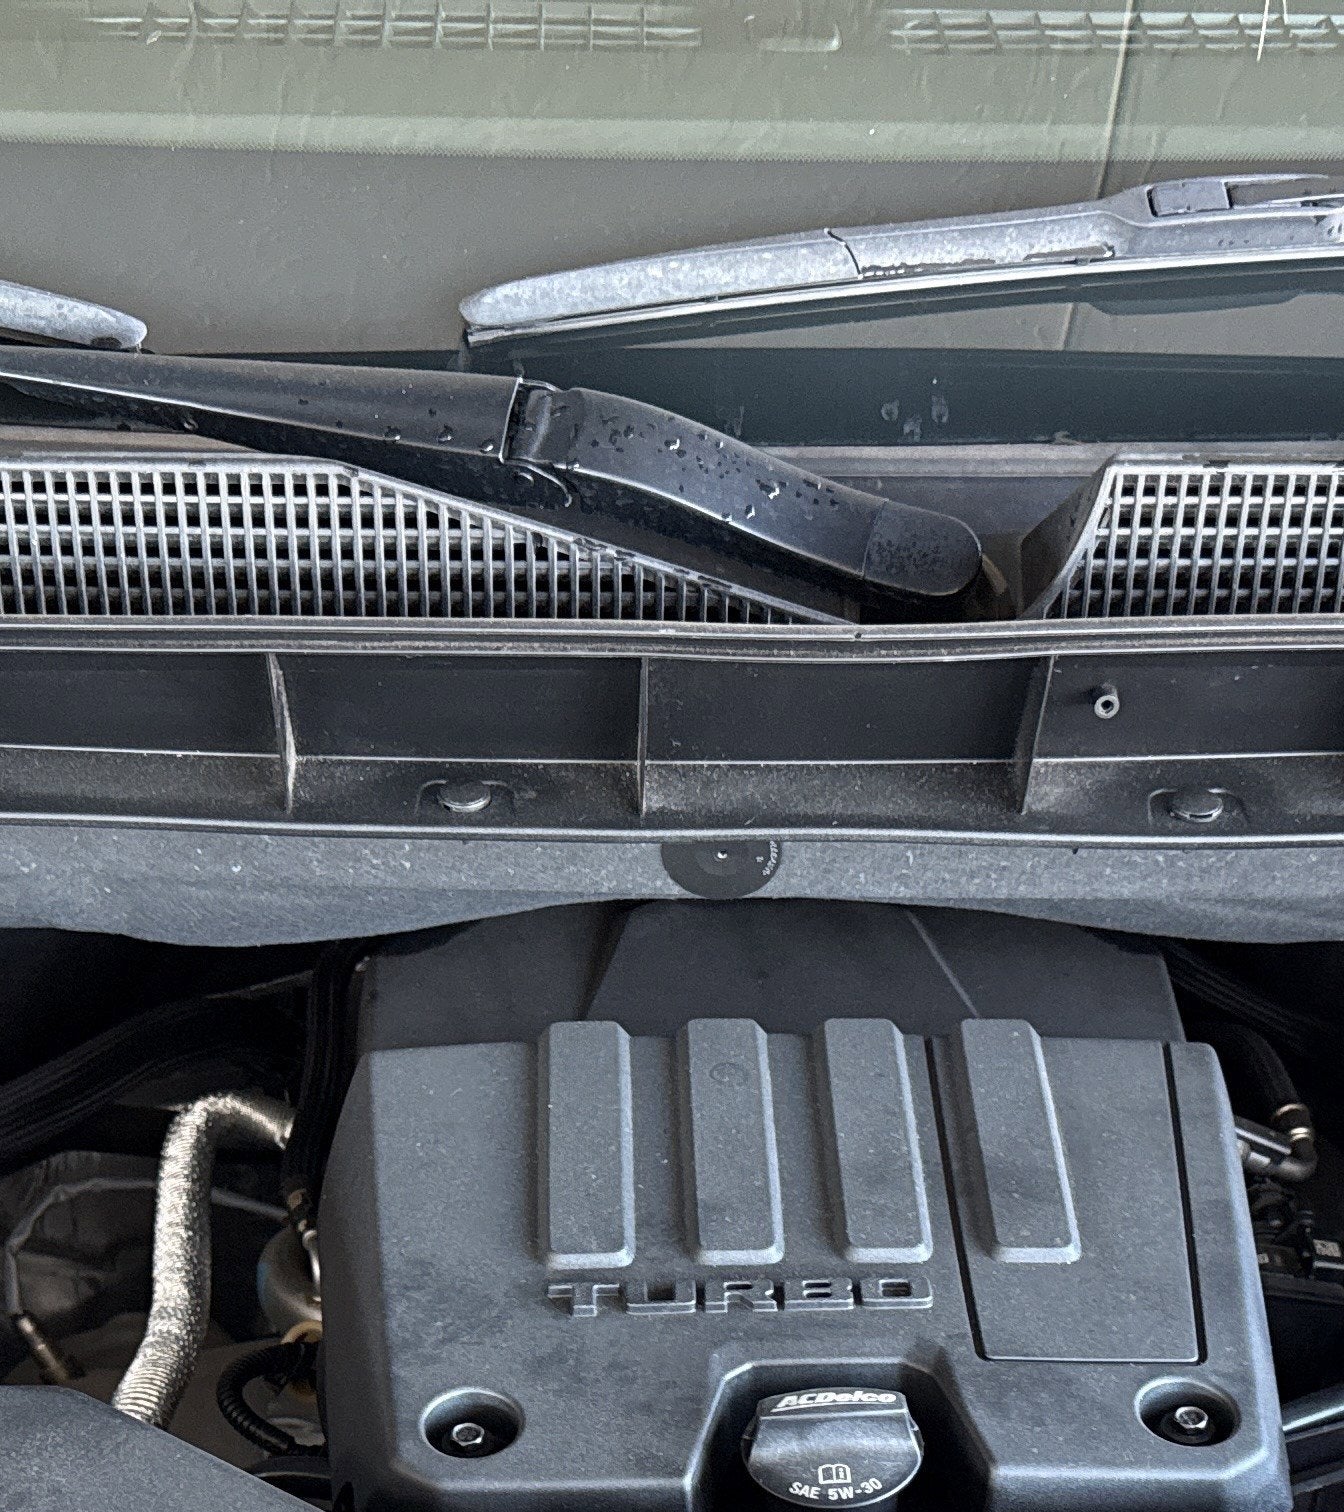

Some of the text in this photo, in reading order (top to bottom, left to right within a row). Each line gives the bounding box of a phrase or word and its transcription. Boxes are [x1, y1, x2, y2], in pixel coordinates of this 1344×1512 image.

[547, 1276, 934, 1318] TURBO
[776, 1390, 897, 1408] ACDelco
[789, 1477, 883, 1501] SAE 5W-30
